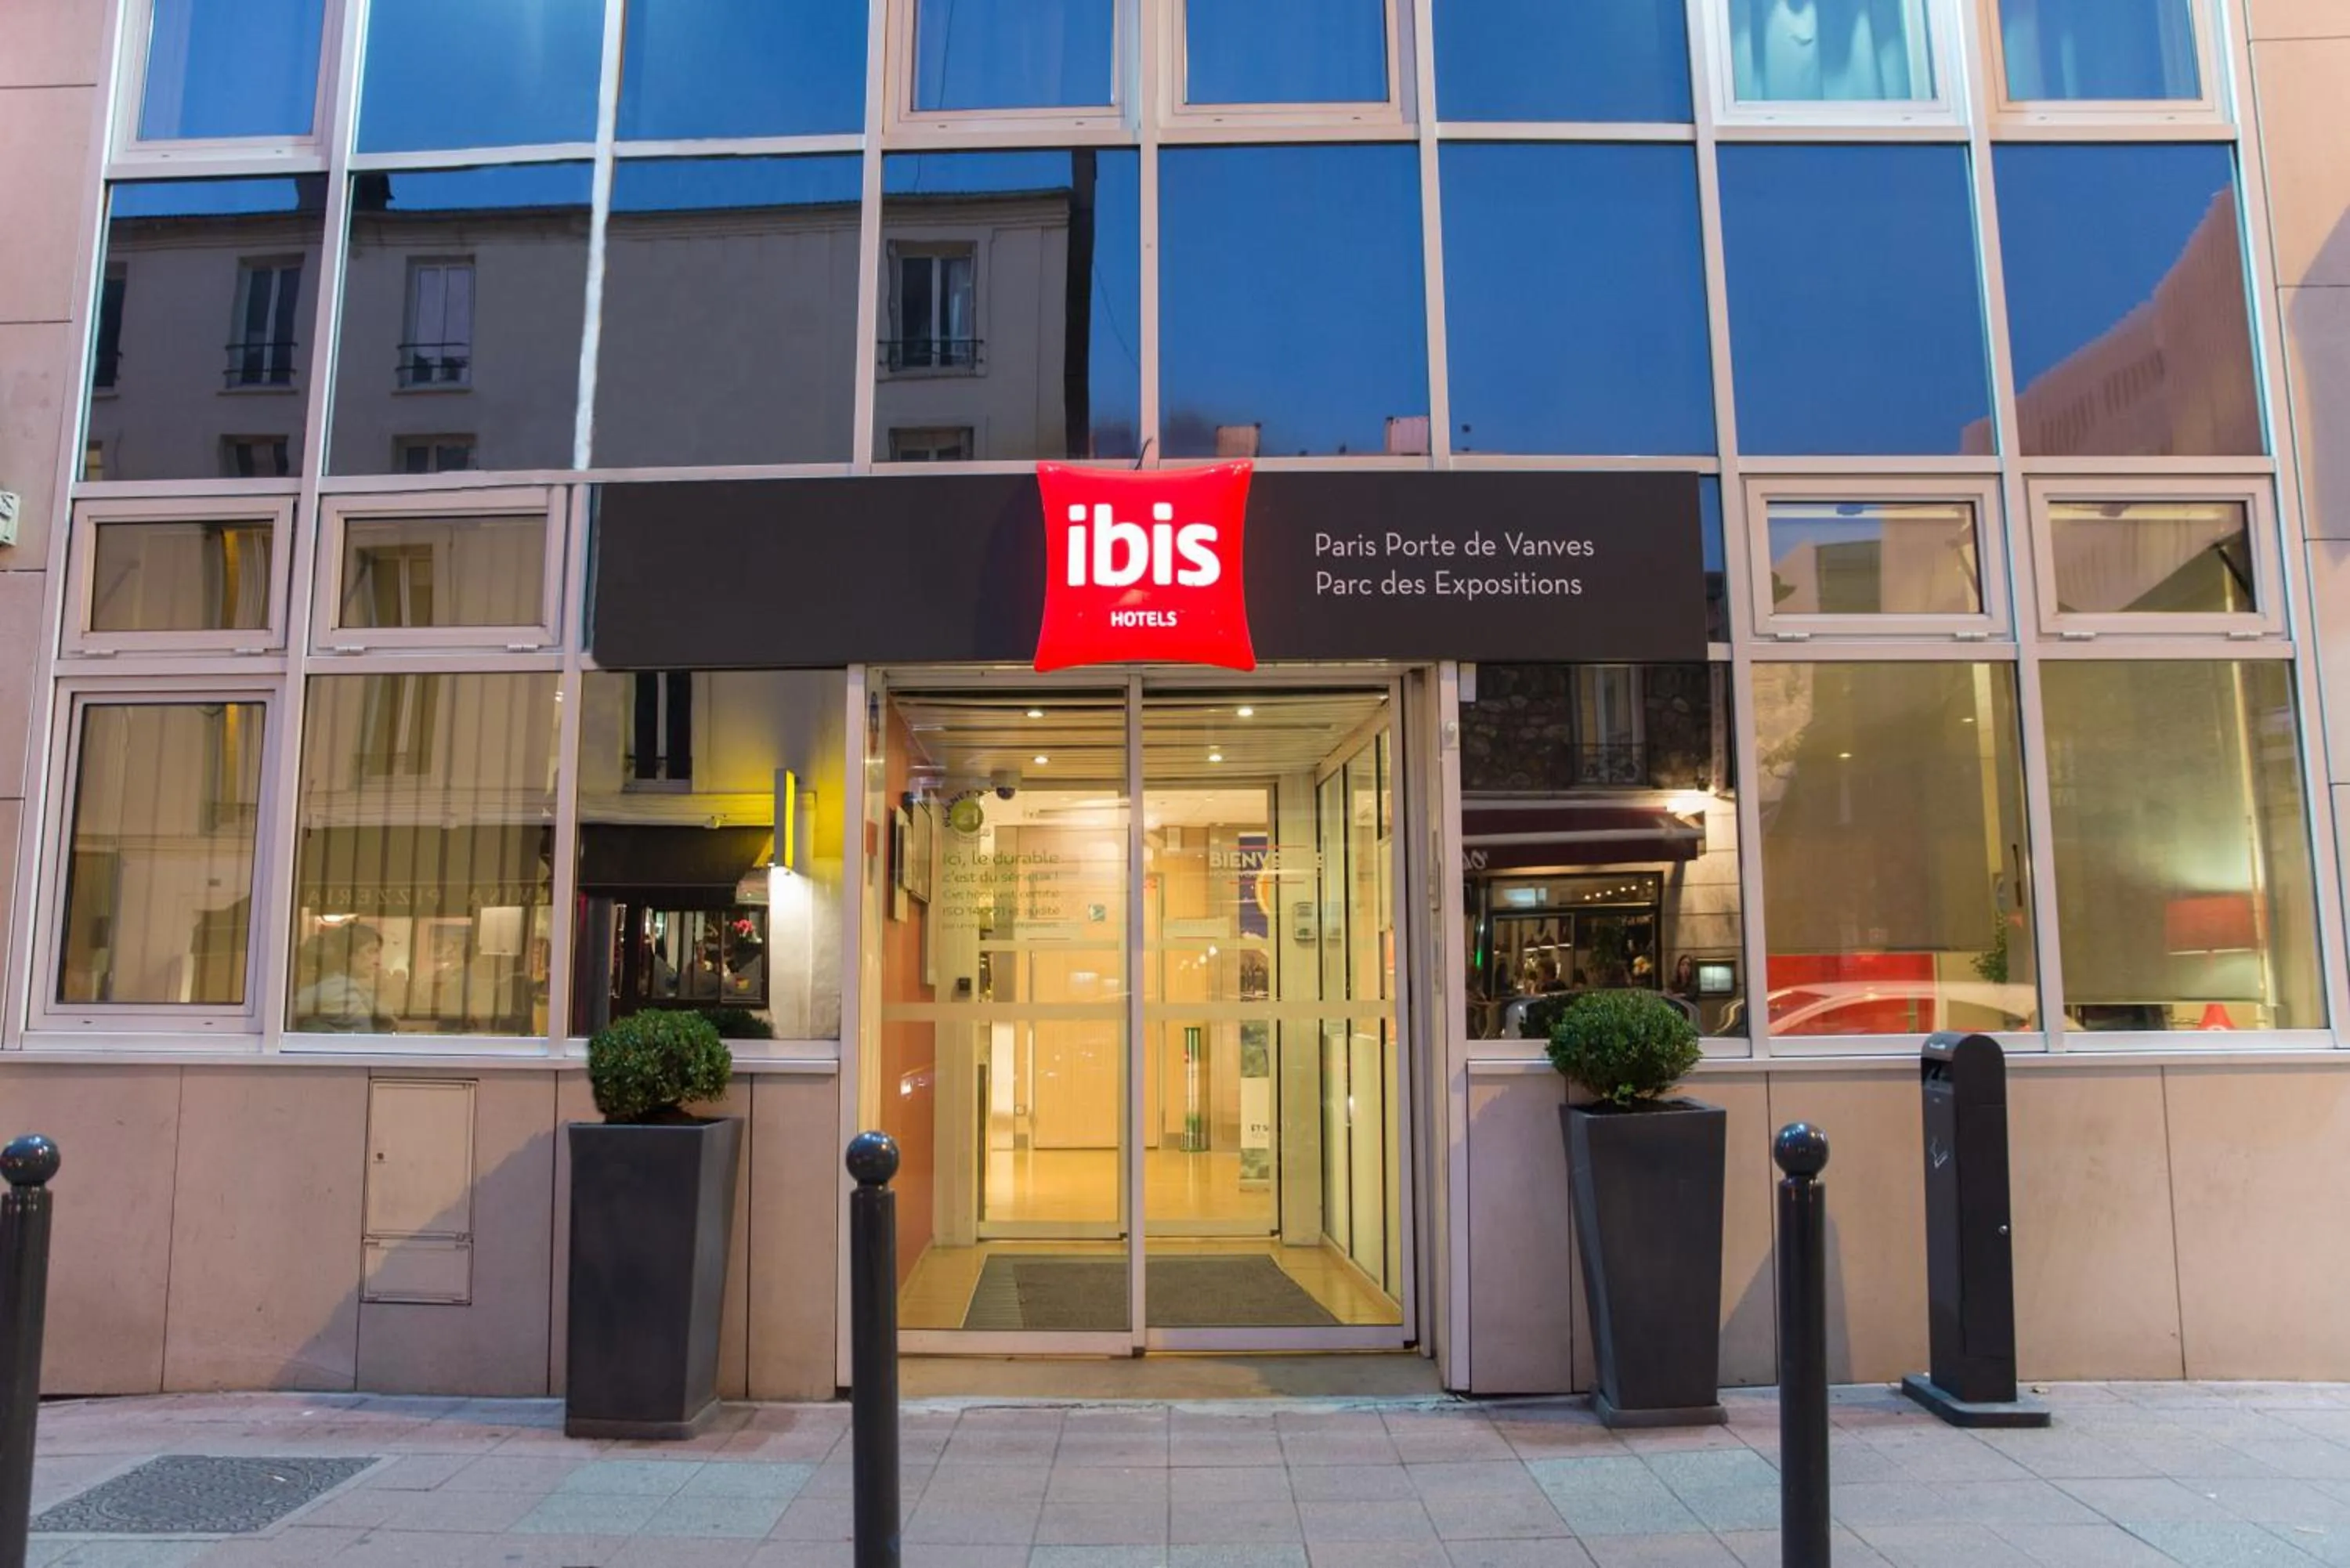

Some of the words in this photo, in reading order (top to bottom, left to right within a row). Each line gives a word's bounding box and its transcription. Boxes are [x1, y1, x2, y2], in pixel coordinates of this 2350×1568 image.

[1068, 502, 1221, 587] ibis
[1315, 533, 1376, 557] Paris
[1386, 532, 1455, 556] Porte
[1464, 529, 1496, 556] de
[1504, 532, 1595, 557] Vanves
[1316, 571, 1372, 595] Parc
[1381, 569, 1426, 595] des
[1435, 570, 1582, 602] Expositions
[1110, 611, 1177, 627] HOTELS
[972, 849, 989, 865] le
[992, 849, 1060, 865] durable
